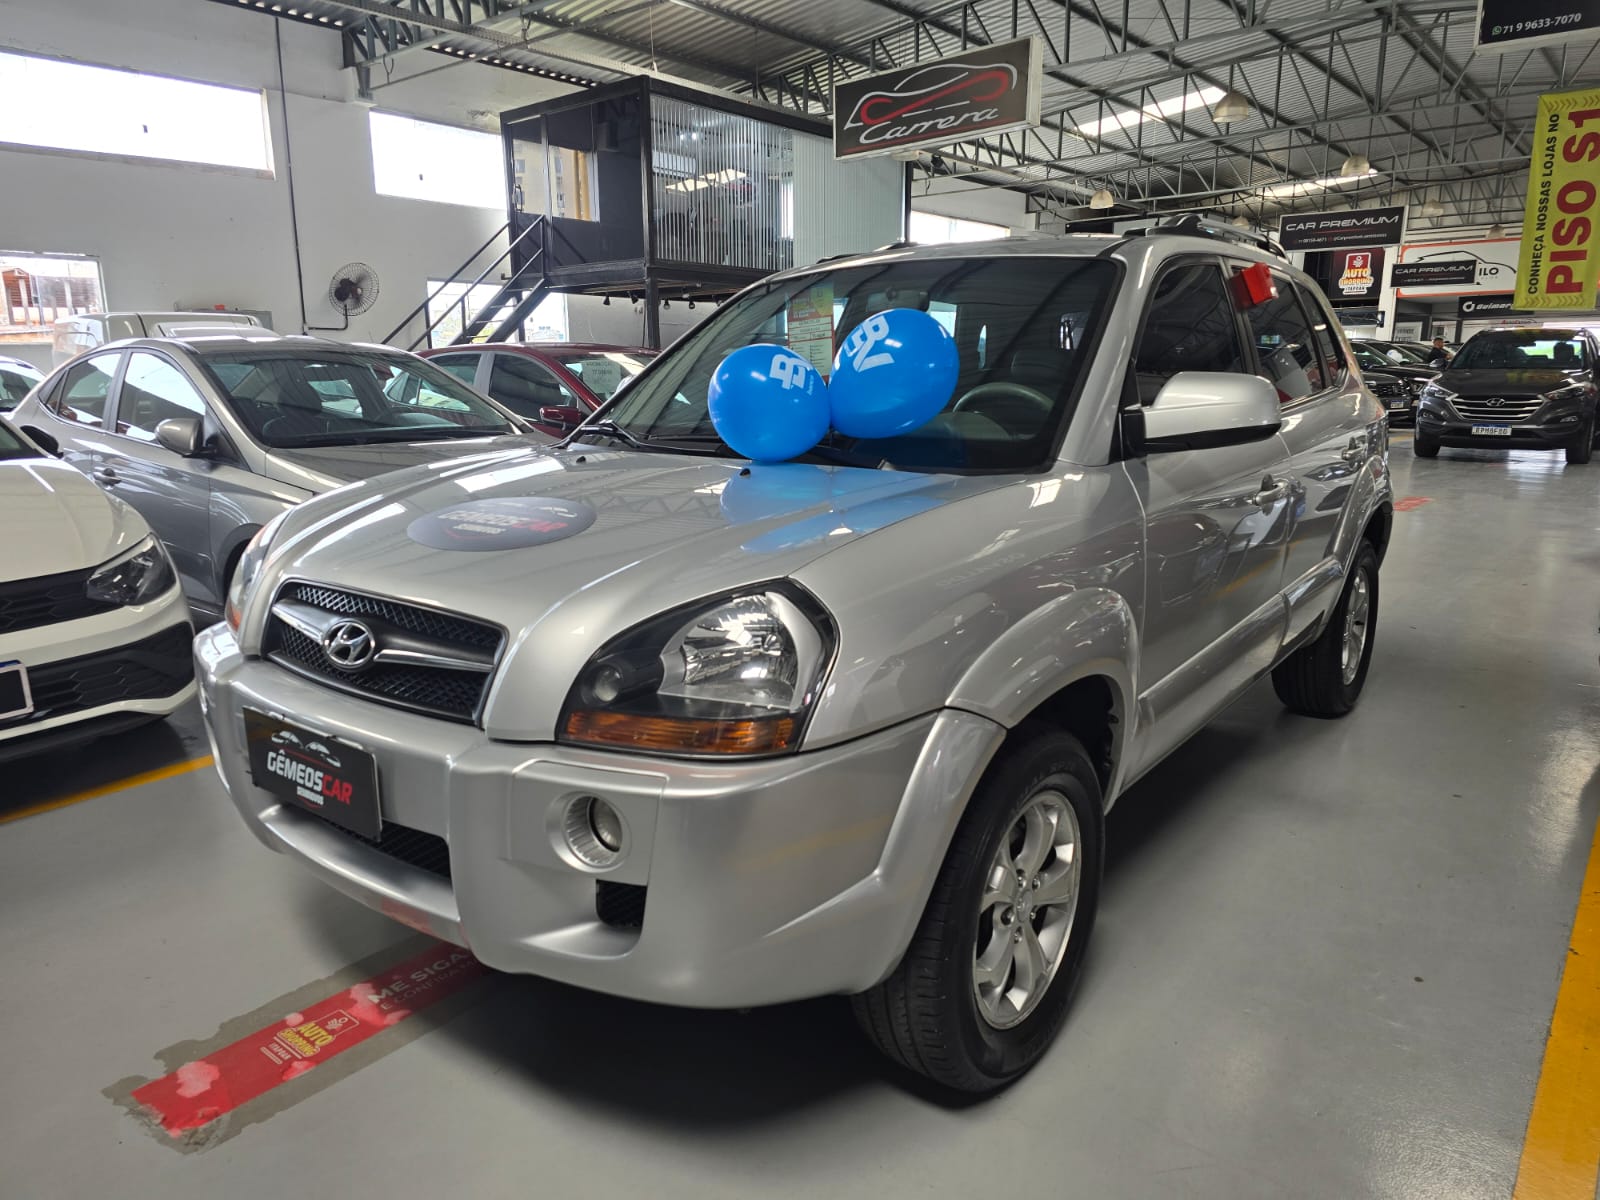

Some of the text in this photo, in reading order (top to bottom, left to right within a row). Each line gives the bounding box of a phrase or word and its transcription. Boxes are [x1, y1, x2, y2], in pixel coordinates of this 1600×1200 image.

[1503, 12, 1582, 34] 71 9 9633-7070
[859, 107, 999, 144] Carrera
[1528, 113, 1560, 294] CONHEÇA NOSSAS LOJAS NO
[1545, 108, 1600, 294] PISO S1
[1286, 215, 1399, 231] CAR PREMIUM
[1343, 268, 1370, 278] AUTO
[1395, 265, 1473, 275] CAR PREMIUM
[410, 953, 470, 982] SIGA
[298, 1022, 334, 1047] AUTO
